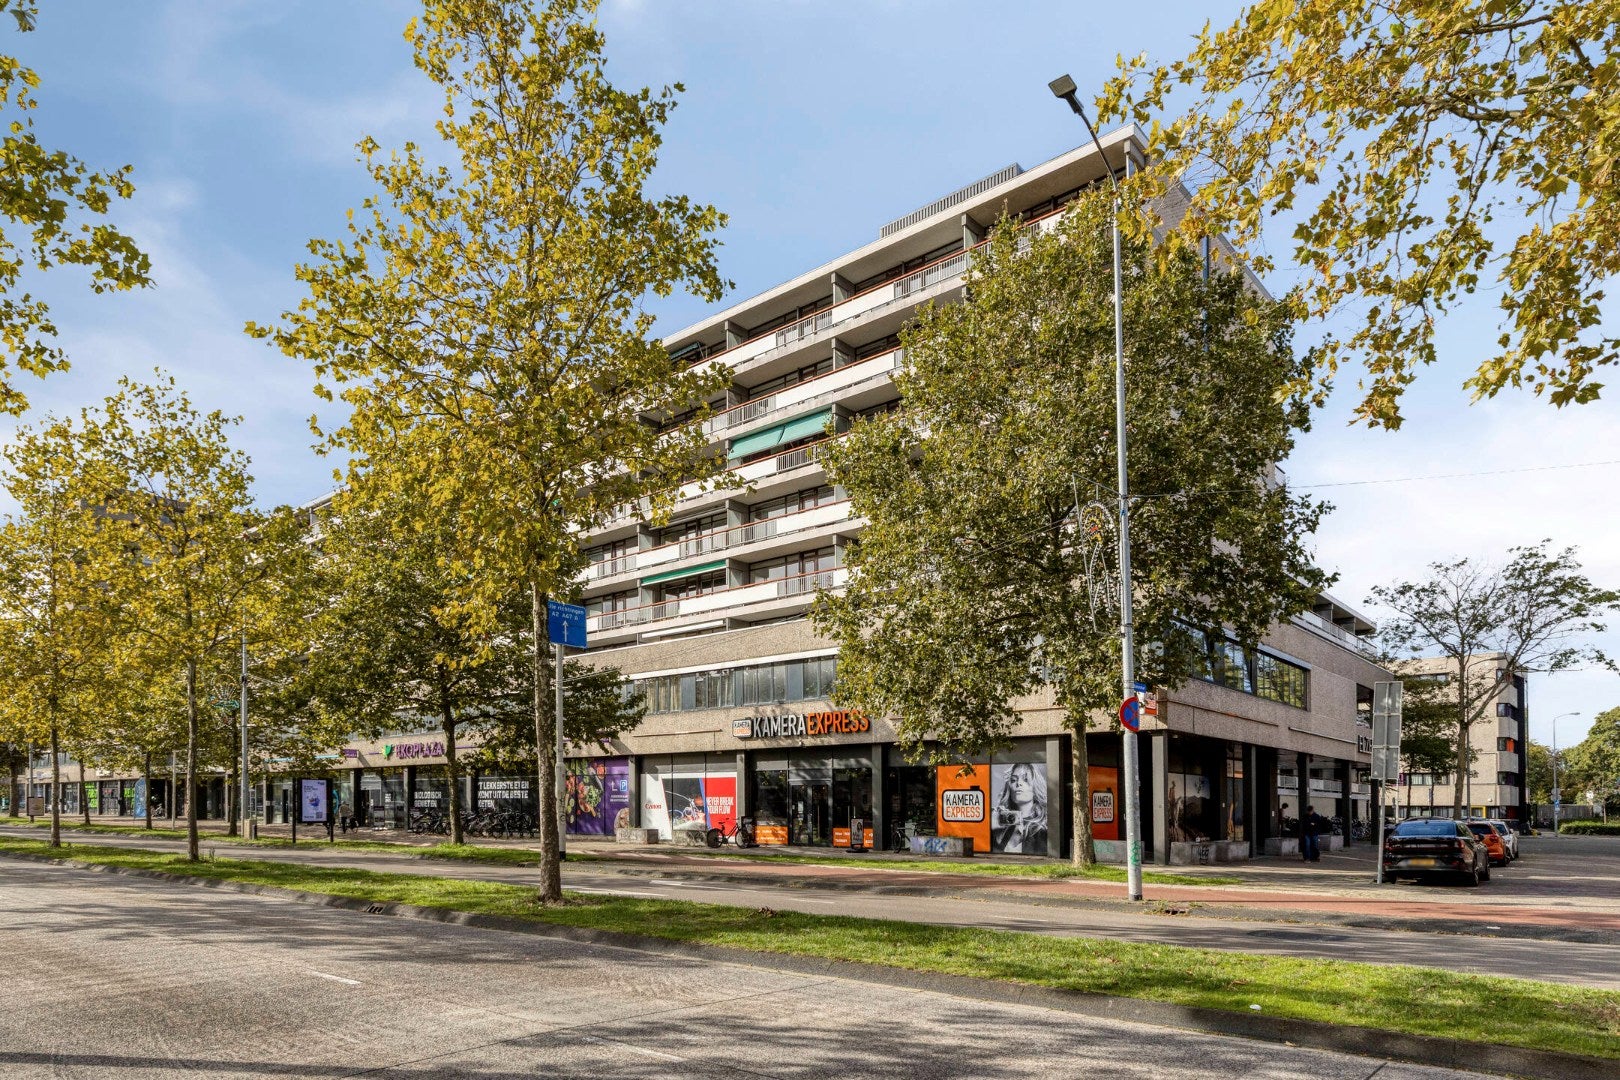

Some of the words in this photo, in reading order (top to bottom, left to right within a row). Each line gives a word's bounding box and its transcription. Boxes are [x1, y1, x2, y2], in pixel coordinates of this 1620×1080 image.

[396, 742, 445, 758] EKOPLAZA
[514, 781, 529, 789] ETEN
[414, 791, 442, 799] BIOLOGISCH
[493, 790, 501, 798] UIT
[502, 790, 509, 798] DE
[510, 790, 529, 798] BESTE
[720, 797, 733, 805] BREAK
[945, 793, 980, 806] KAMERA
[1093, 793, 1113, 807] KAMERA
[707, 806, 718, 814] YOUR
[719, 806, 730, 814] FLOW
[946, 806, 980, 818] EXPRESS
[1093, 806, 1113, 819] EXPRESS
